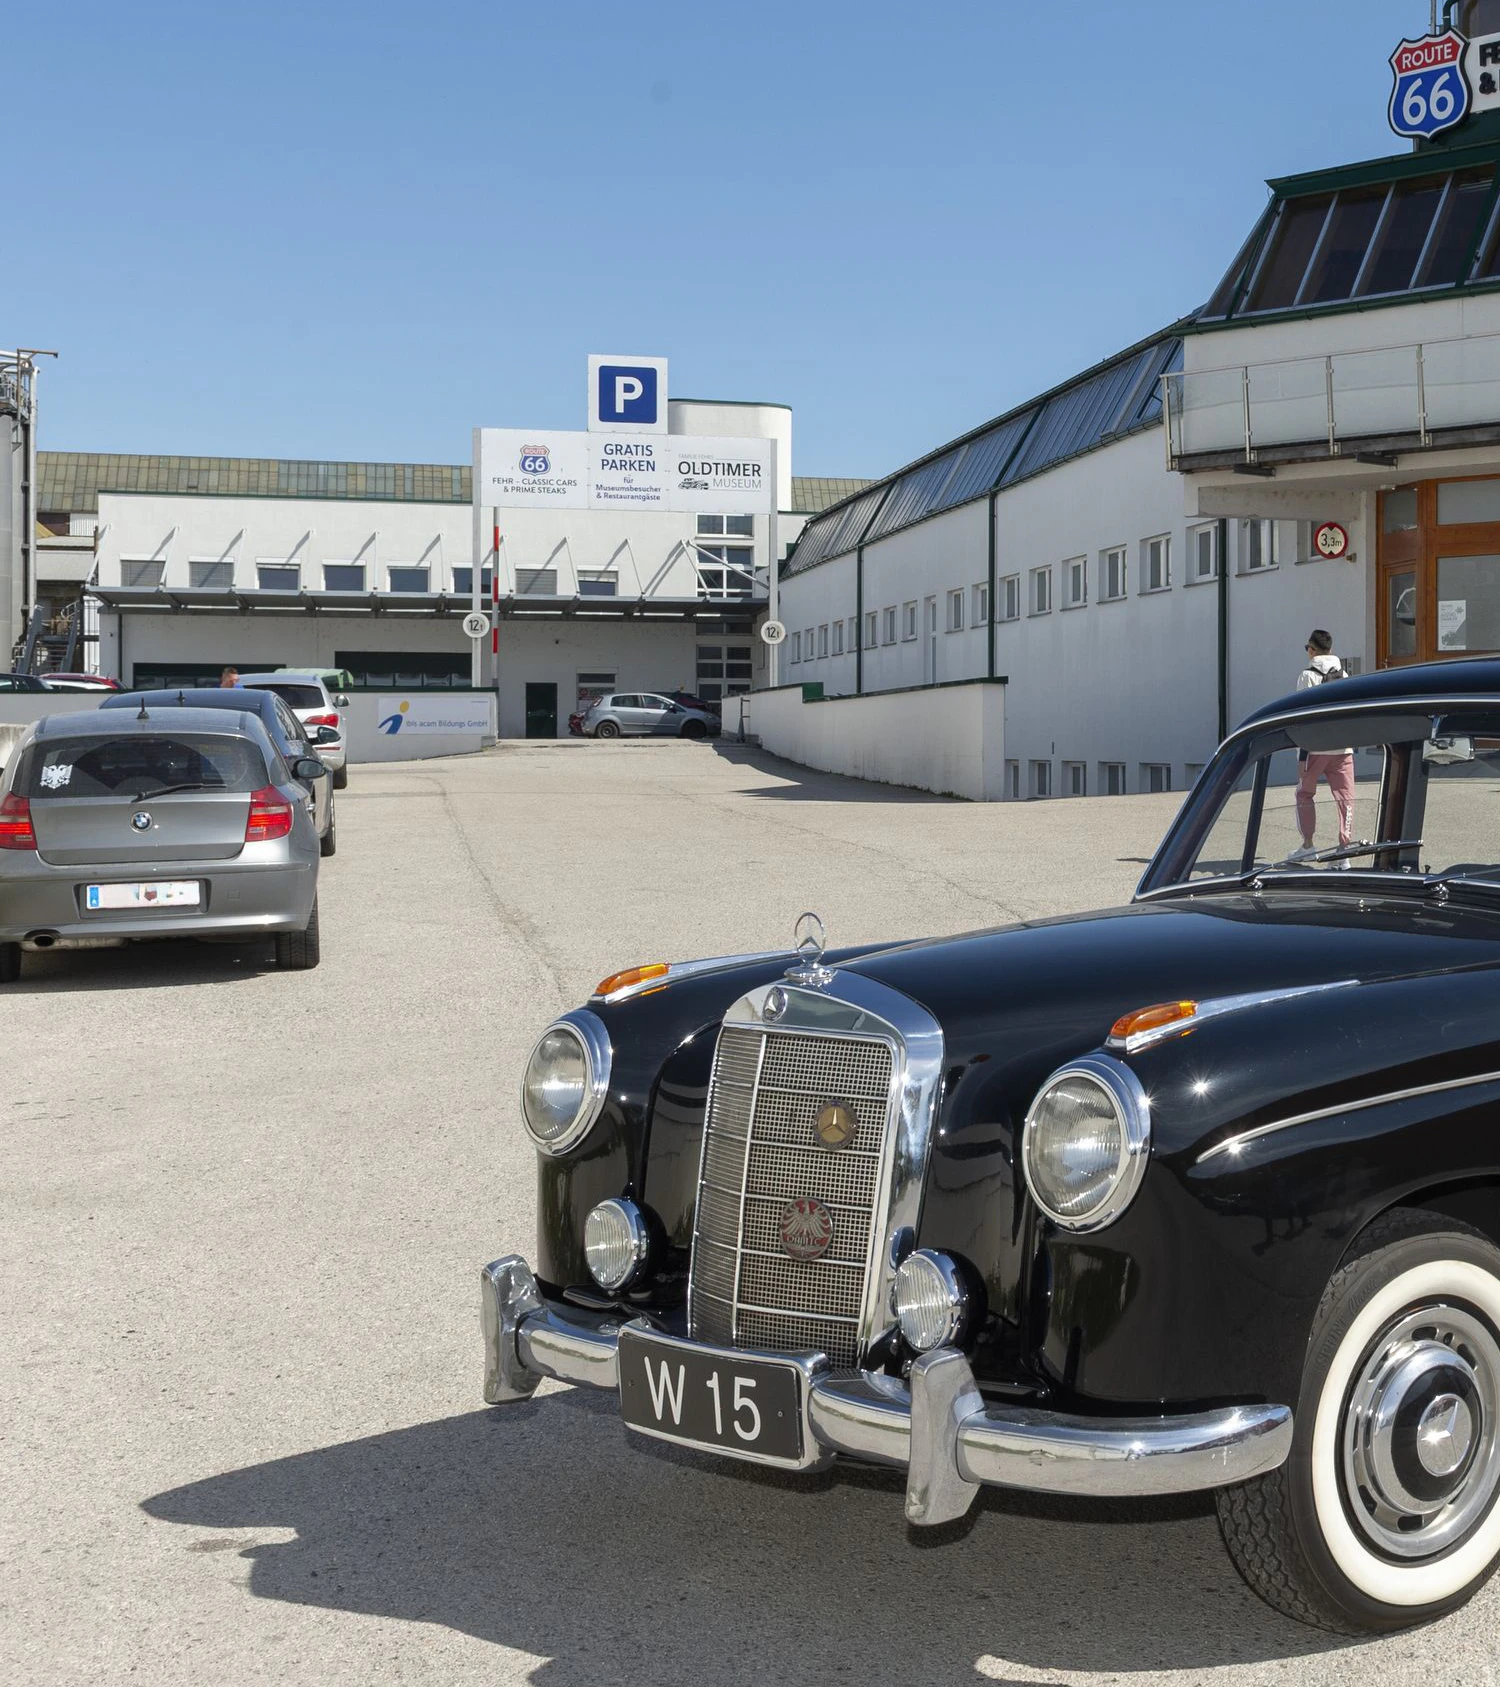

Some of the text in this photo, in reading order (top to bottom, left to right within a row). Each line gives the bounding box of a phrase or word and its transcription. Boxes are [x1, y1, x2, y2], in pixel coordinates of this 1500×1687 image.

[1402, 43, 1453, 69] ROUTE
[1479, 72, 1497, 94] &
[1402, 72, 1455, 125] 66
[615, 376, 644, 413] P
[604, 443, 653, 456] GRATIS
[524, 456, 546, 471] 66
[601, 458, 656, 471] PARKEN
[678, 461, 761, 477] OLDTIMER
[492, 477, 514, 485] FEHR
[521, 478, 555, 486] CLASSIC
[555, 479, 578, 487] CARS
[623, 476, 634, 484] für
[713, 478, 762, 488] MUSEUM
[537, 486, 567, 495] STEAKS
[595, 484, 661, 492] Museumsbesucher
[603, 492, 661, 502] Restaurantgäste
[438, 719, 466, 728] Bildungs
[643, 1356, 762, 1442] W 15
